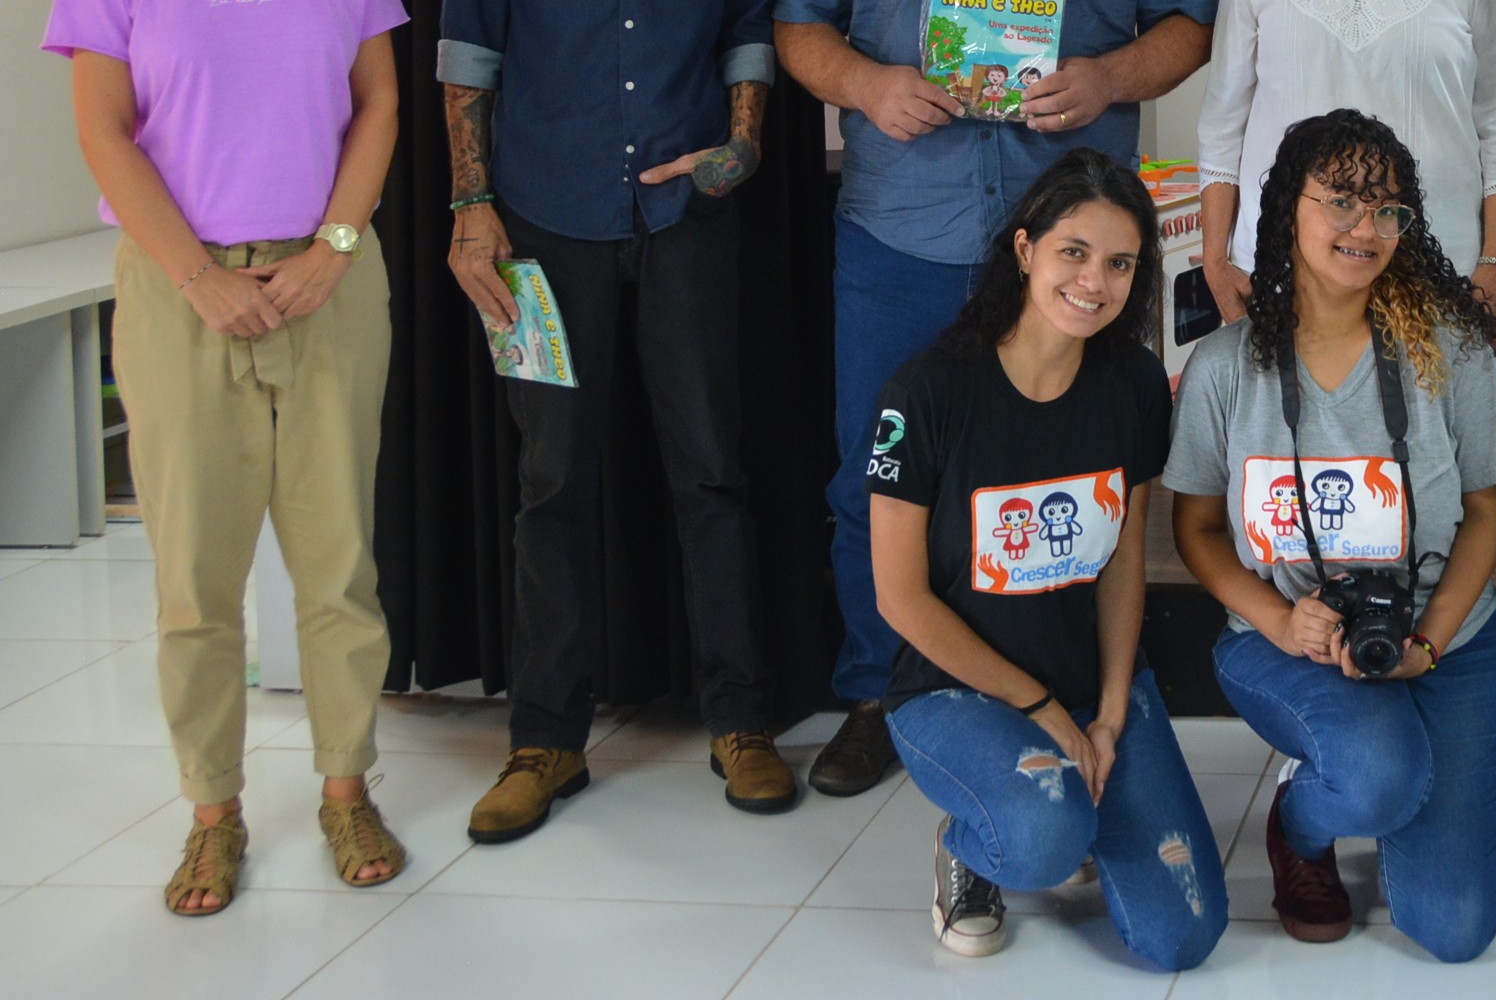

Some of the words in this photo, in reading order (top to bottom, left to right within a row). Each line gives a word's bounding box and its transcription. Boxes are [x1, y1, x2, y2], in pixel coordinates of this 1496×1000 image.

[988, 19, 1008, 29] Uma
[866, 458, 900, 482] DCA
[1272, 533, 1340, 553] Creser
[1341, 539, 1399, 556] Seguro
[1010, 556, 1076, 583] Crescer
[1370, 596, 1392, 605] Canon
